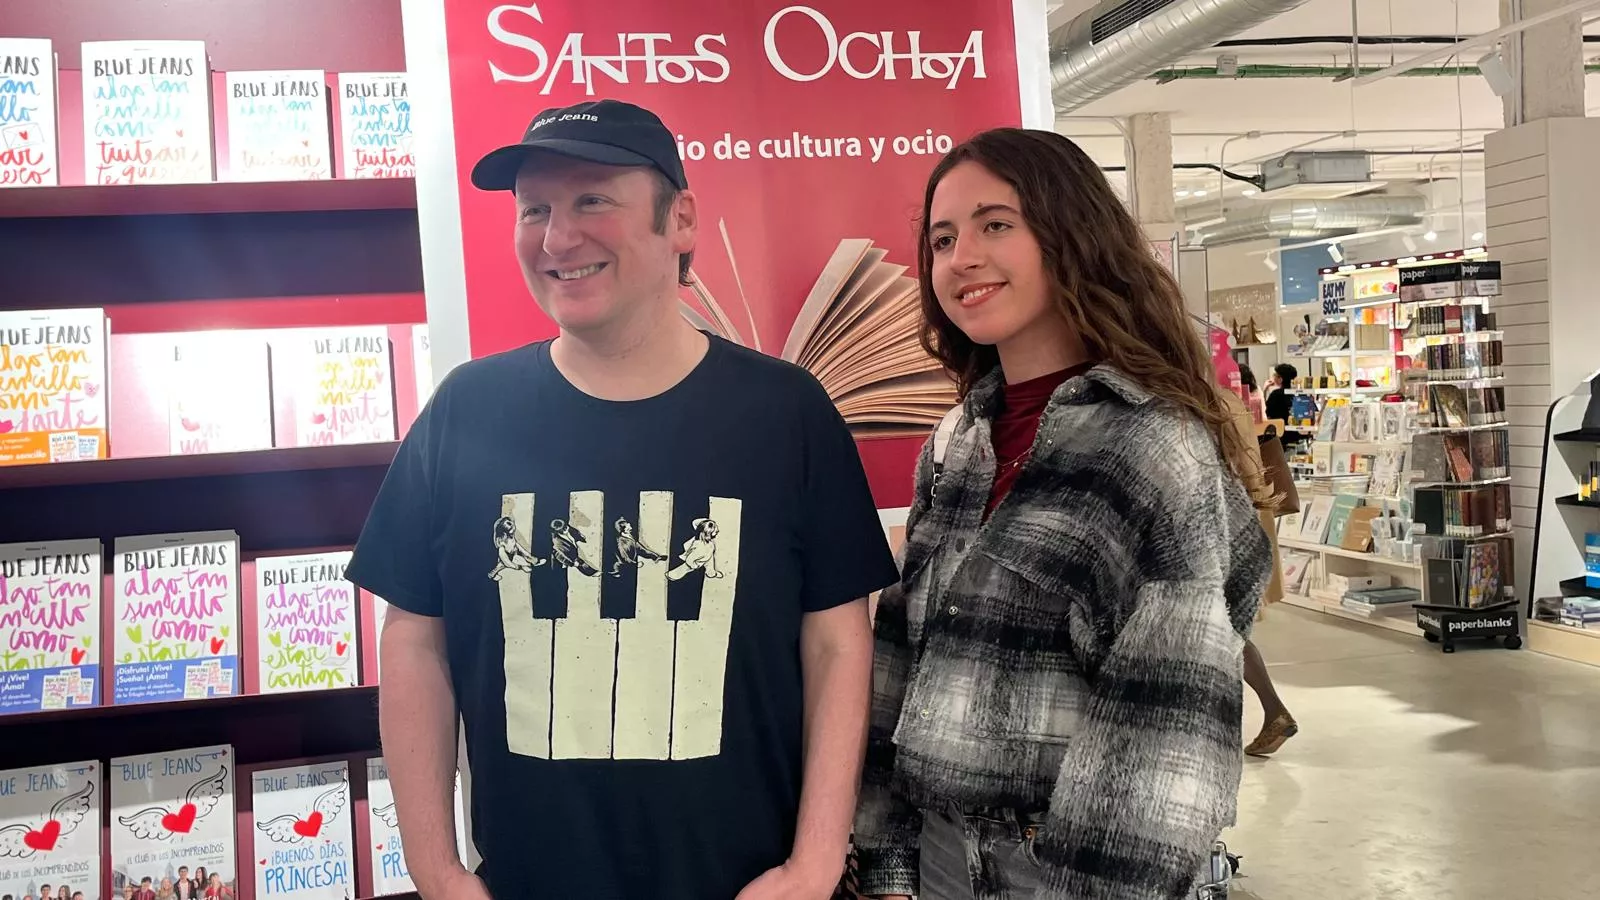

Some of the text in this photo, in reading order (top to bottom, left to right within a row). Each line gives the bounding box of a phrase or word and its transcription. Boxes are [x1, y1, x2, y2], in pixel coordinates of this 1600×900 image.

[0, 56, 40, 77] ANS
[94, 57, 194, 77] BLUE JEANS
[233, 81, 319, 98] BLUE JEANS
[346, 82, 408, 98] BLUE JEA
[392, 98, 411, 112] ta
[353, 148, 416, 166] tuitea
[677, 129, 953, 163] io de cultura y ocio
[35, 325, 92, 346] JEANS
[337, 336, 383, 354] JEANS
[0, 343, 92, 383] lgo tan
[0, 391, 60, 411] omo
[0, 553, 91, 579] UE JEANS
[124, 545, 228, 573] BLUE JEANS
[124, 564, 228, 609] algo tan
[263, 563, 349, 587] BLUE JEANS
[0, 573, 91, 618] lgo tan
[121, 588, 228, 624] sencillo
[266, 582, 349, 619] algo tan
[264, 602, 349, 630] sencillo
[1448, 616, 1513, 632] paperblanks
[10, 628, 75, 652] como
[152, 618, 214, 642] como
[289, 626, 338, 646] como
[261, 643, 327, 670] estar
[267, 659, 346, 690] contigo
[122, 755, 203, 781] BLUE JEANS
[0, 777, 16, 795] UE
[263, 770, 328, 793] BLUE JEANS
[271, 845, 315, 865] ¡BUENOS
[265, 860, 348, 894] PRINCESA!
